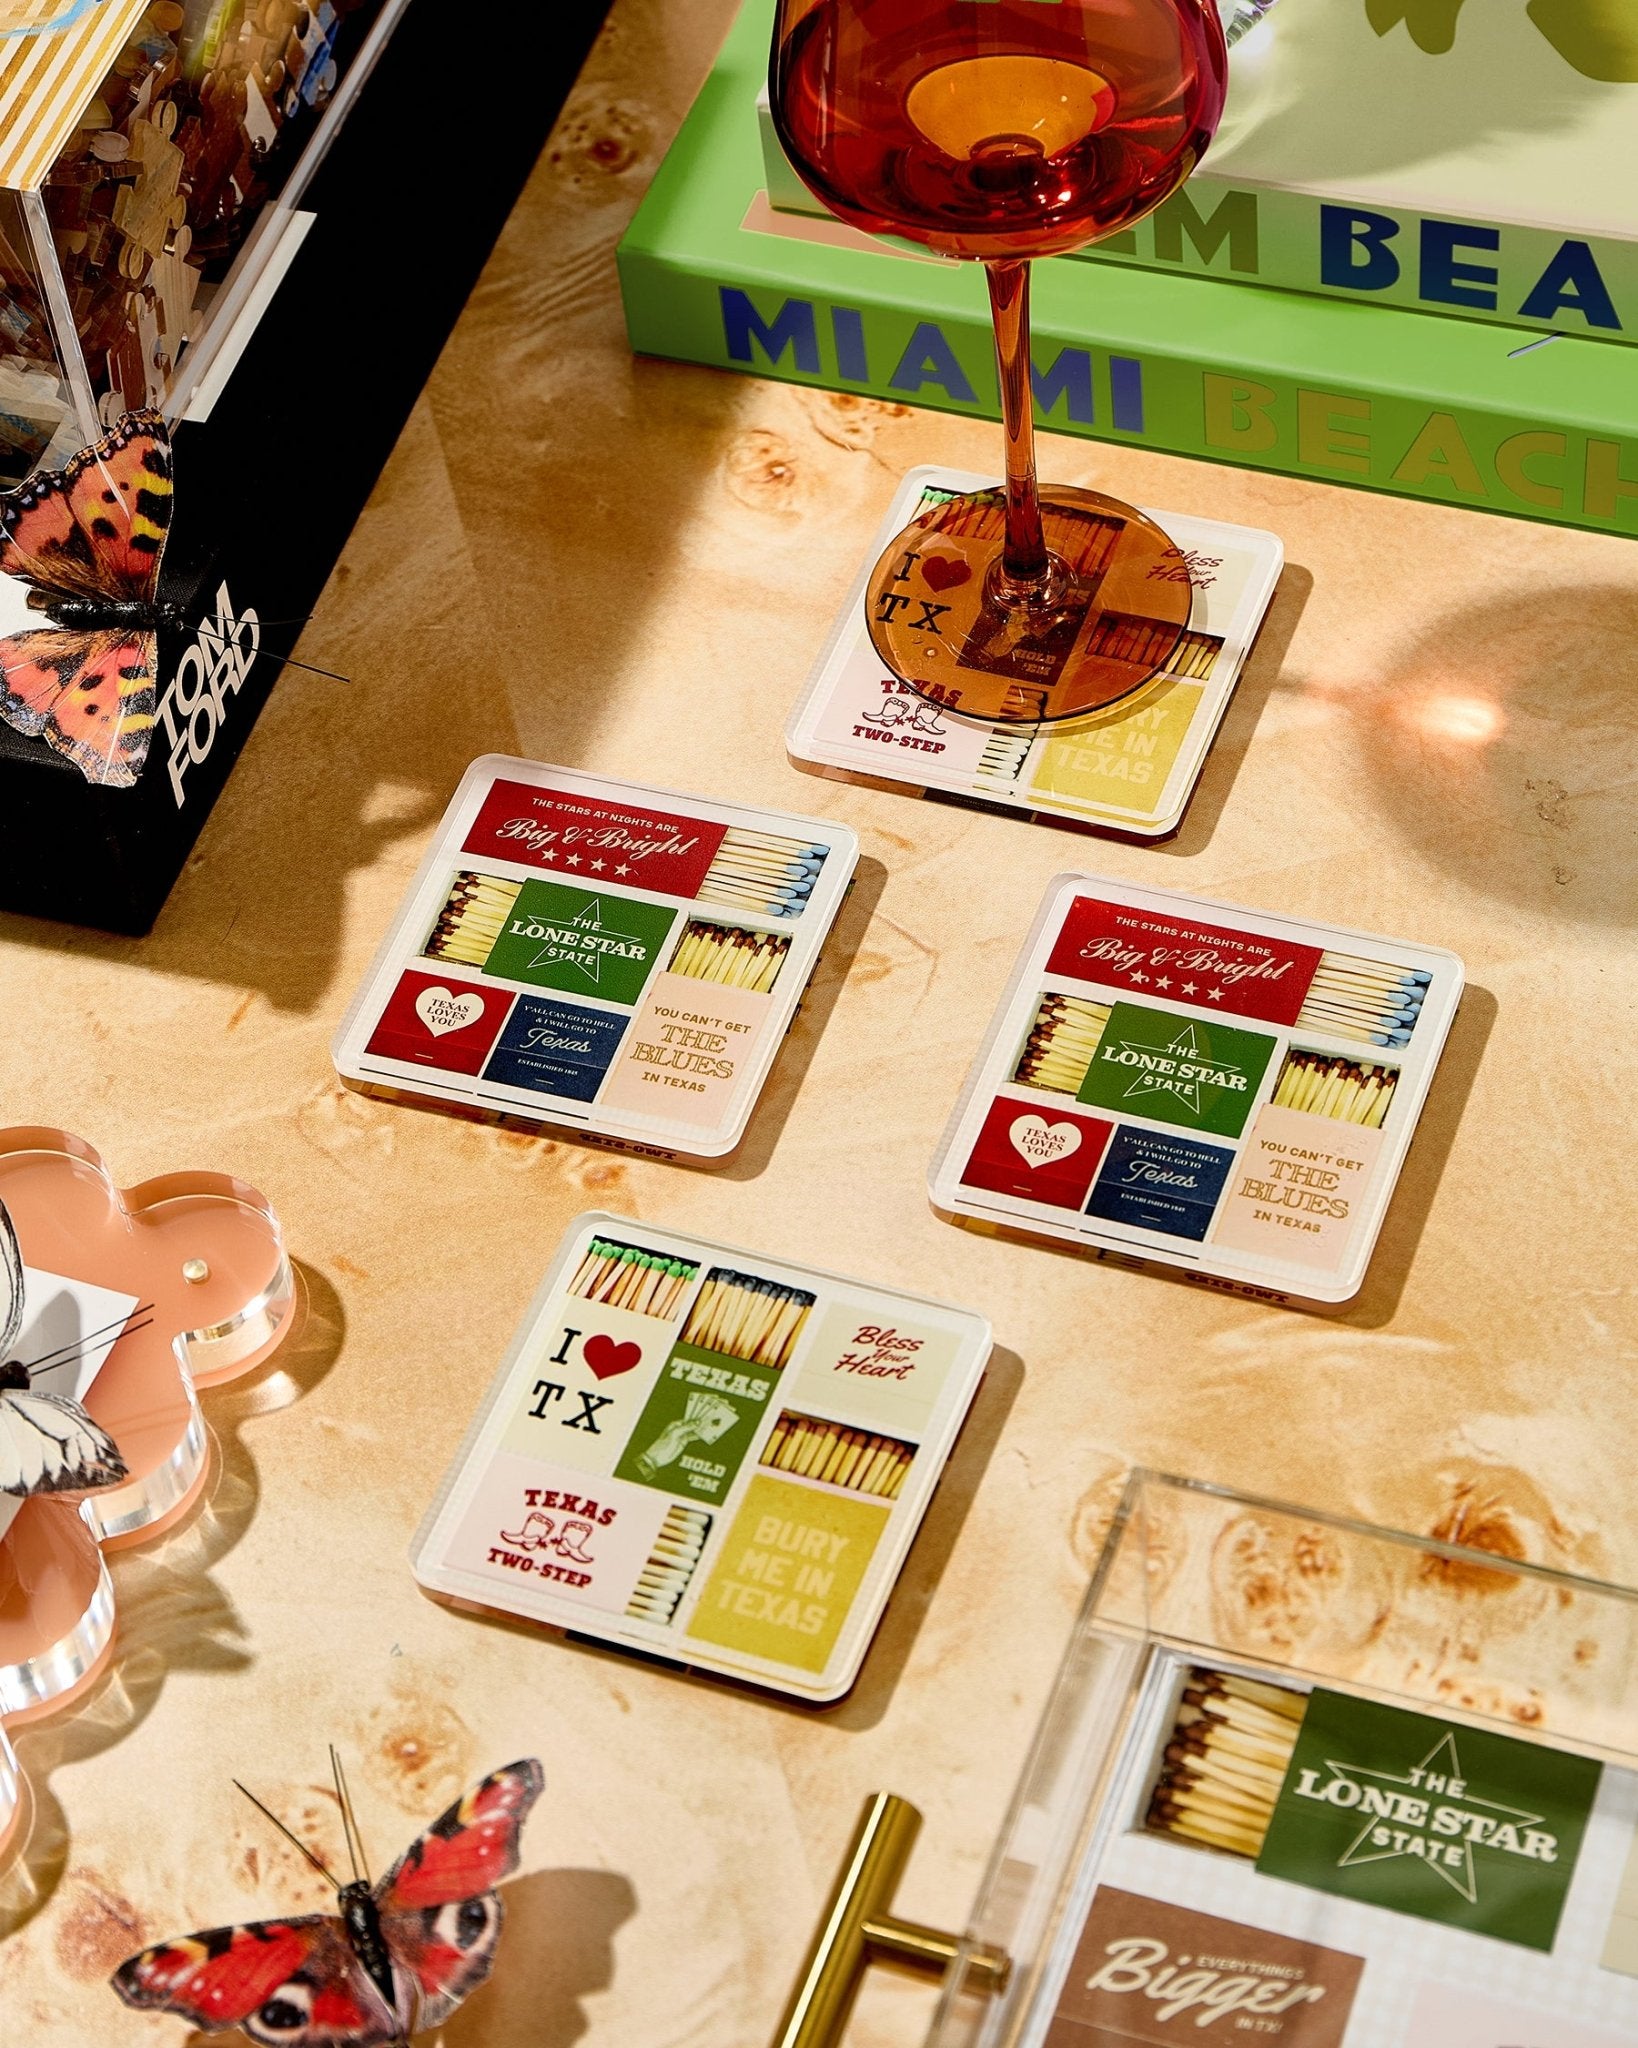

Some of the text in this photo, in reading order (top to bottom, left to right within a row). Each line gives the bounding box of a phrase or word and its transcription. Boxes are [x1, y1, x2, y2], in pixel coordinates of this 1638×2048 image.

[1320, 204, 1623, 331] BEA
[718, 285, 1145, 434] MIAMI
[893, 551, 921, 581] I
[153, 579, 236, 750] TOM
[167, 607, 260, 810] FORD
[852, 725, 946, 754] TWO-STEP
[1123, 731, 1158, 756] IN
[1057, 744, 1154, 784] TEXAS
[532, 798, 679, 834] THE STARS AT NIGHTS ARE
[496, 817, 699, 861] Big & Bright
[571, 917, 603, 931] THE
[1115, 916, 1272, 957] THE STARS AT NIGHTS ARE
[509, 920, 647, 961] LONE STAR
[547, 947, 597, 965] STATE
[1079, 937, 1295, 985] Big & Bright
[426, 1007, 467, 1021] LOVES
[431, 998, 470, 1013] TEXAS
[524, 1005, 616, 1030] Y'ALL CAN GO TO HELL
[654, 1006, 751, 1034] YOU CAN'T GET
[430, 1015, 456, 1027] YOU
[549, 1019, 570, 1030] WILL
[571, 1024, 584, 1032] GO
[584, 1027, 597, 1035] TO
[519, 1027, 592, 1053] Texas
[661, 1023, 728, 1053] THE
[1167, 1043, 1199, 1060] THE
[517, 1058, 564, 1072] ESTABLISHED
[629, 1042, 734, 1079] BLUES
[1101, 1046, 1248, 1092] LONE STAR
[641, 1071, 706, 1092] IN TEXAS
[1143, 1075, 1196, 1095] STATE
[1021, 1135, 1064, 1152] LOVES
[1026, 1127, 1067, 1143] TEXAS
[1026, 1145, 1053, 1158] YOU
[1123, 1136, 1222, 1165] Y'ALL CAN GO TO HELL
[1150, 1152, 1174, 1163] WILL
[1174, 1157, 1188, 1166] GO
[1188, 1160, 1202, 1169] TO
[1260, 1140, 1364, 1172] YOU CAN'T GET
[1121, 1159, 1199, 1189] Texas
[1269, 1159, 1340, 1192] THE
[1239, 1178, 1349, 1219] BLUES
[1253, 1210, 1321, 1233] IN TEXAS
[549, 1327, 582, 1365] I
[852, 1326, 924, 1351] Bless
[834, 1354, 915, 1380] Heart
[872, 1348, 910, 1363] Your
[670, 1357, 771, 1402] TEXAS
[678, 1455, 727, 1478] HOLD
[525, 1489, 617, 1526] TEXAS
[753, 1515, 850, 1564] BURY
[487, 1548, 592, 1588] TWO-STEP
[737, 1548, 835, 1599] ME IN
[718, 1580, 828, 1635] TEXAS
[1408, 1766, 1468, 1799] THE
[1293, 1768, 1558, 1863] LONE STAR
[1370, 1826, 1465, 1867] STATE
[1086, 1936, 1327, 2028] Bigger
